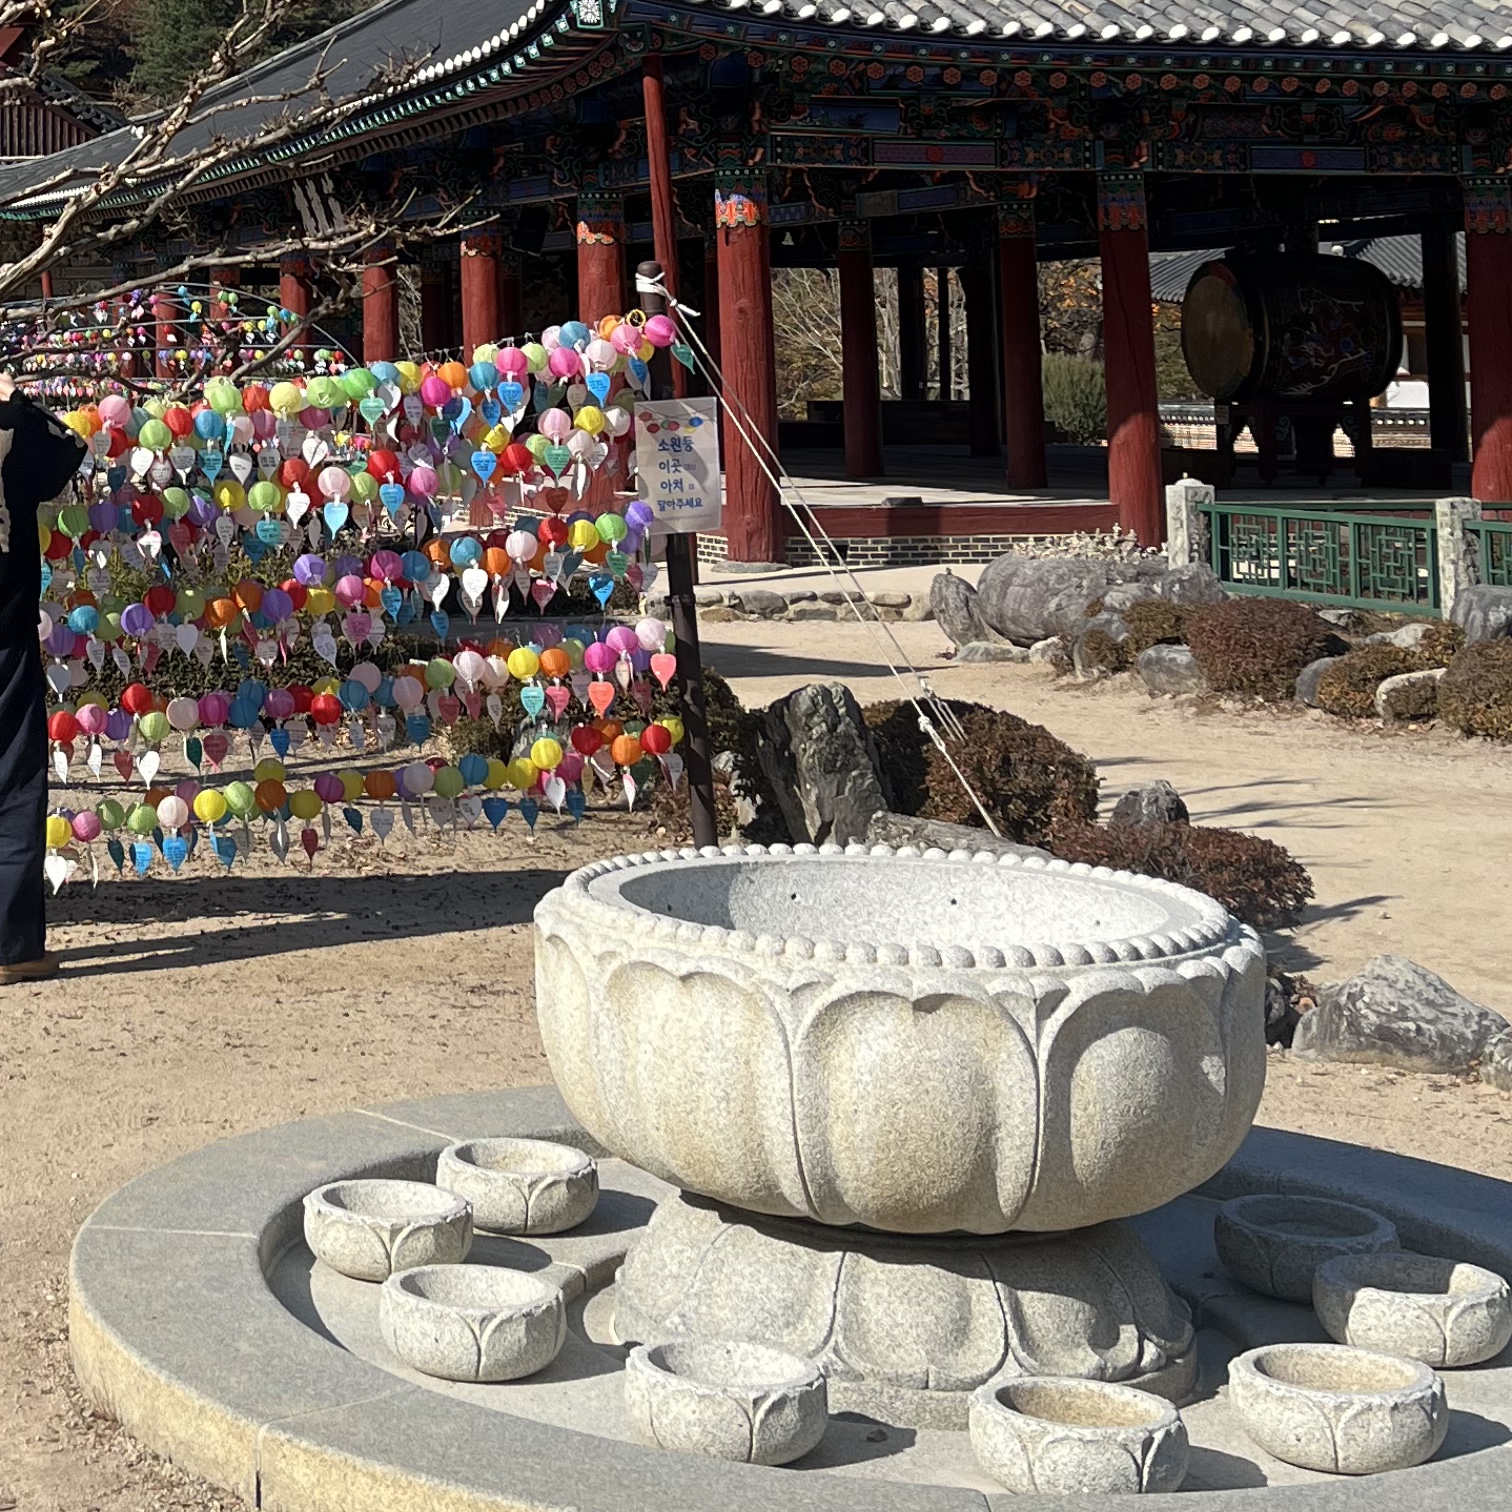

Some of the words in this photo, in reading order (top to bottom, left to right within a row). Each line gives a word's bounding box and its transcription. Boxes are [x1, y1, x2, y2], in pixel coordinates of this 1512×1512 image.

[657, 436, 694, 452] 소원등
[658, 458, 682, 474] 이곳
[660, 477, 684, 493] 아치
[656, 497, 703, 512] 달아주세요
